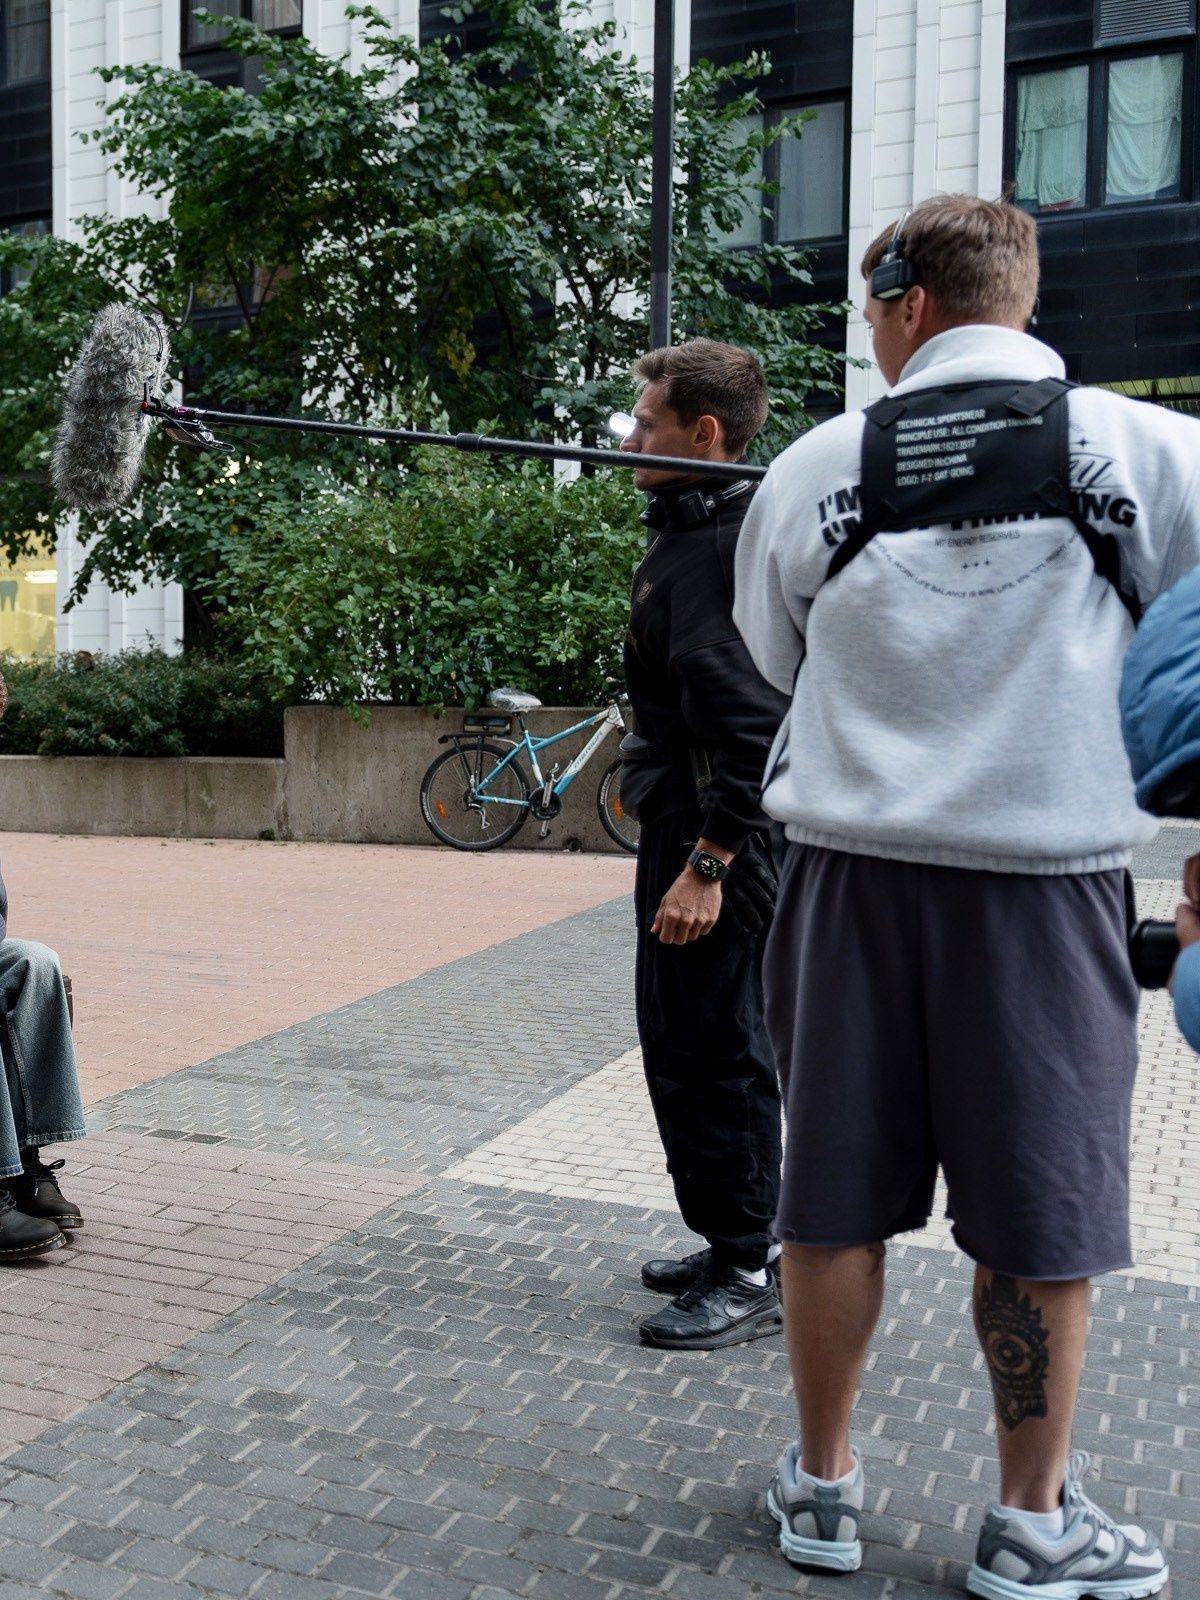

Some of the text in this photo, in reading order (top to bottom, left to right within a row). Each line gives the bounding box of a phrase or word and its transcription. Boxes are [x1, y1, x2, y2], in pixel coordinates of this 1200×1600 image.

[895, 430, 933, 443] PRINCIPLE
[951, 425, 966, 436] ALL
[966, 418, 1007, 434] CONDITION
[896, 459, 934, 472] DESIGNED
